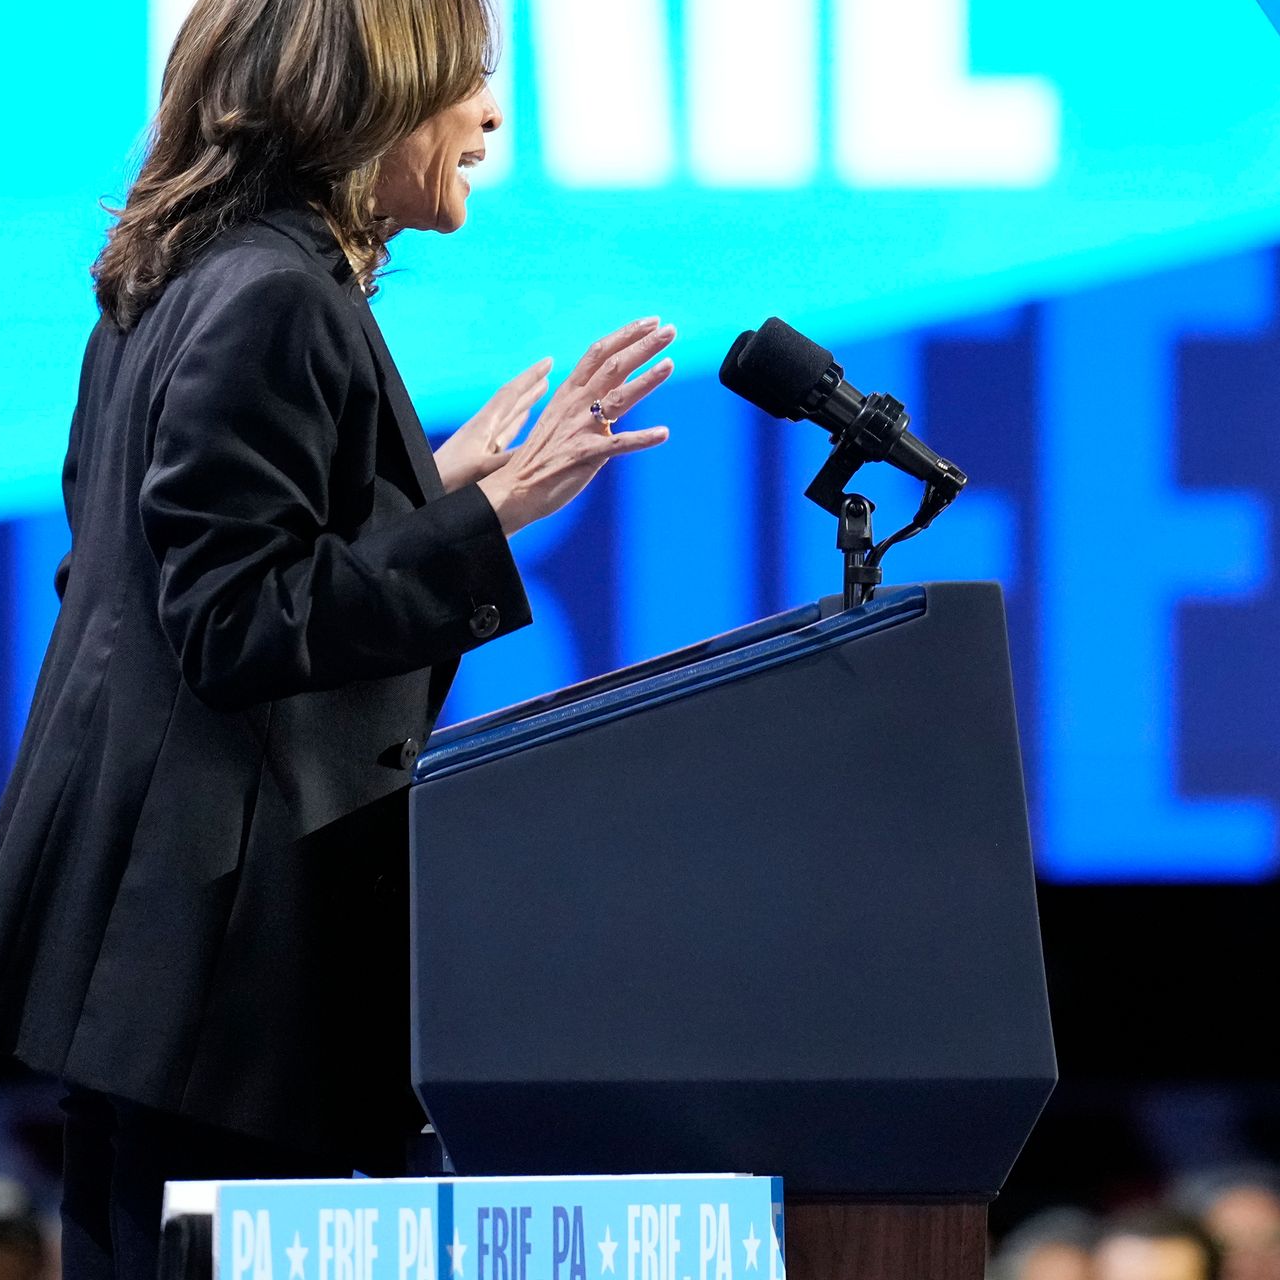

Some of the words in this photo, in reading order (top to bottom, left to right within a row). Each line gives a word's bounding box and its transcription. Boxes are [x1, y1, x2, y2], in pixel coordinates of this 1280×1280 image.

[232, 1209, 272, 1280] PA
[398, 1207, 437, 1280] PA
[553, 1206, 587, 1280] PA
[700, 1203, 733, 1280] PA
